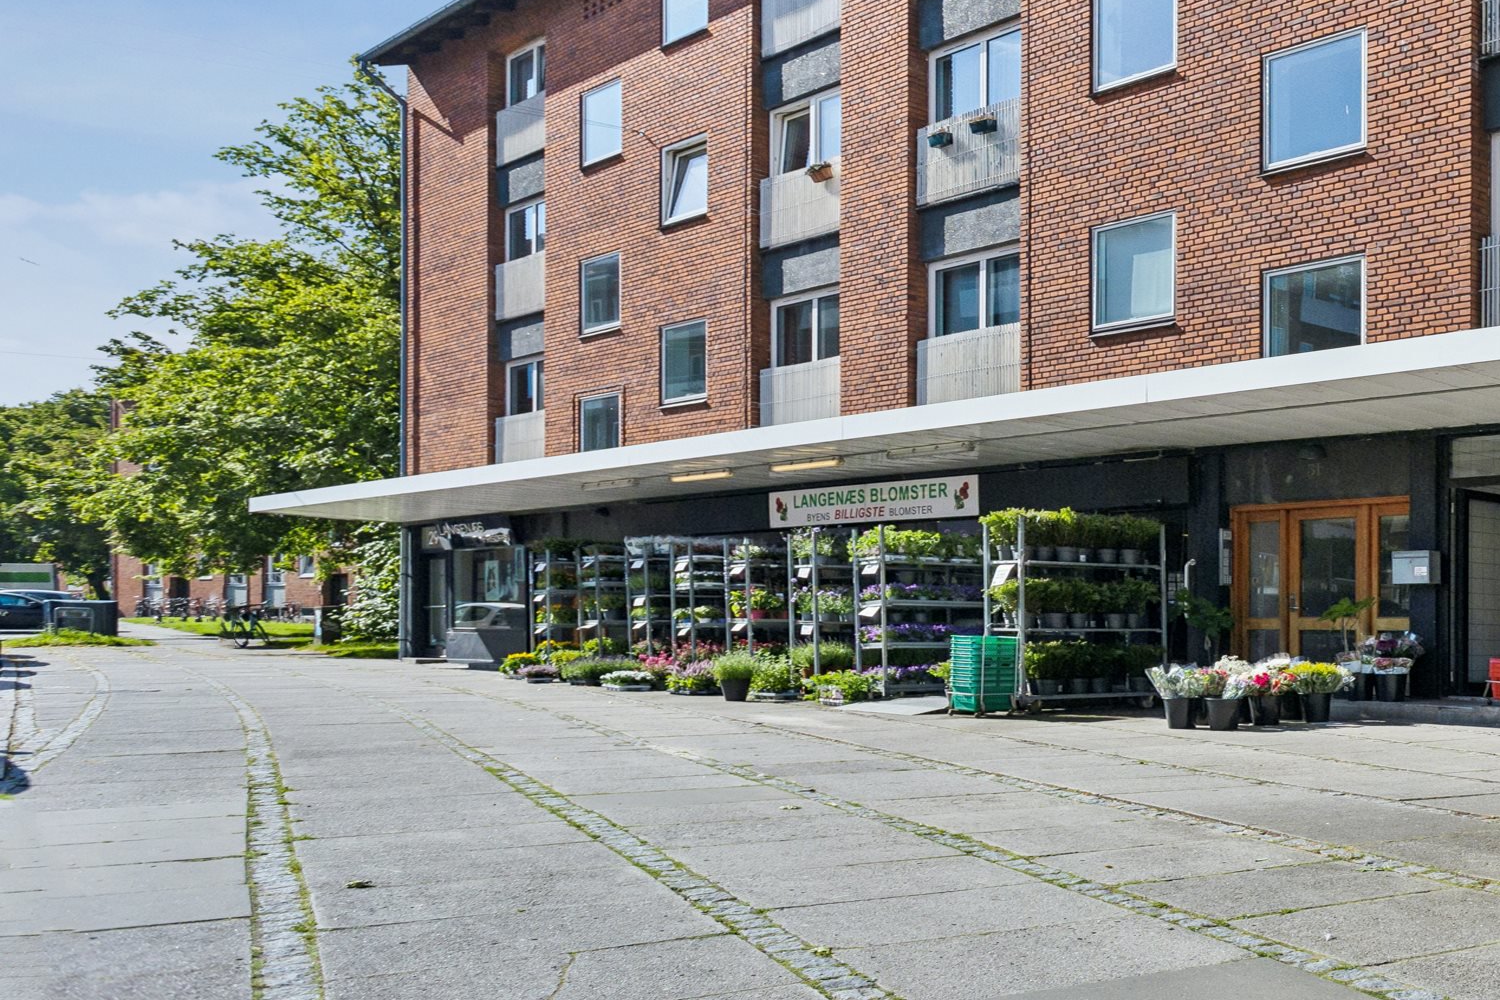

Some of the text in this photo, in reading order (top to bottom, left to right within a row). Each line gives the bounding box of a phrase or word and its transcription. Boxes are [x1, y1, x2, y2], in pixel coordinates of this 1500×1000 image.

[793, 482, 948, 509] LANGENÆS BLOMSTER
[806, 505, 933, 522] BYENS BILLIGSTE BLOMSTER
